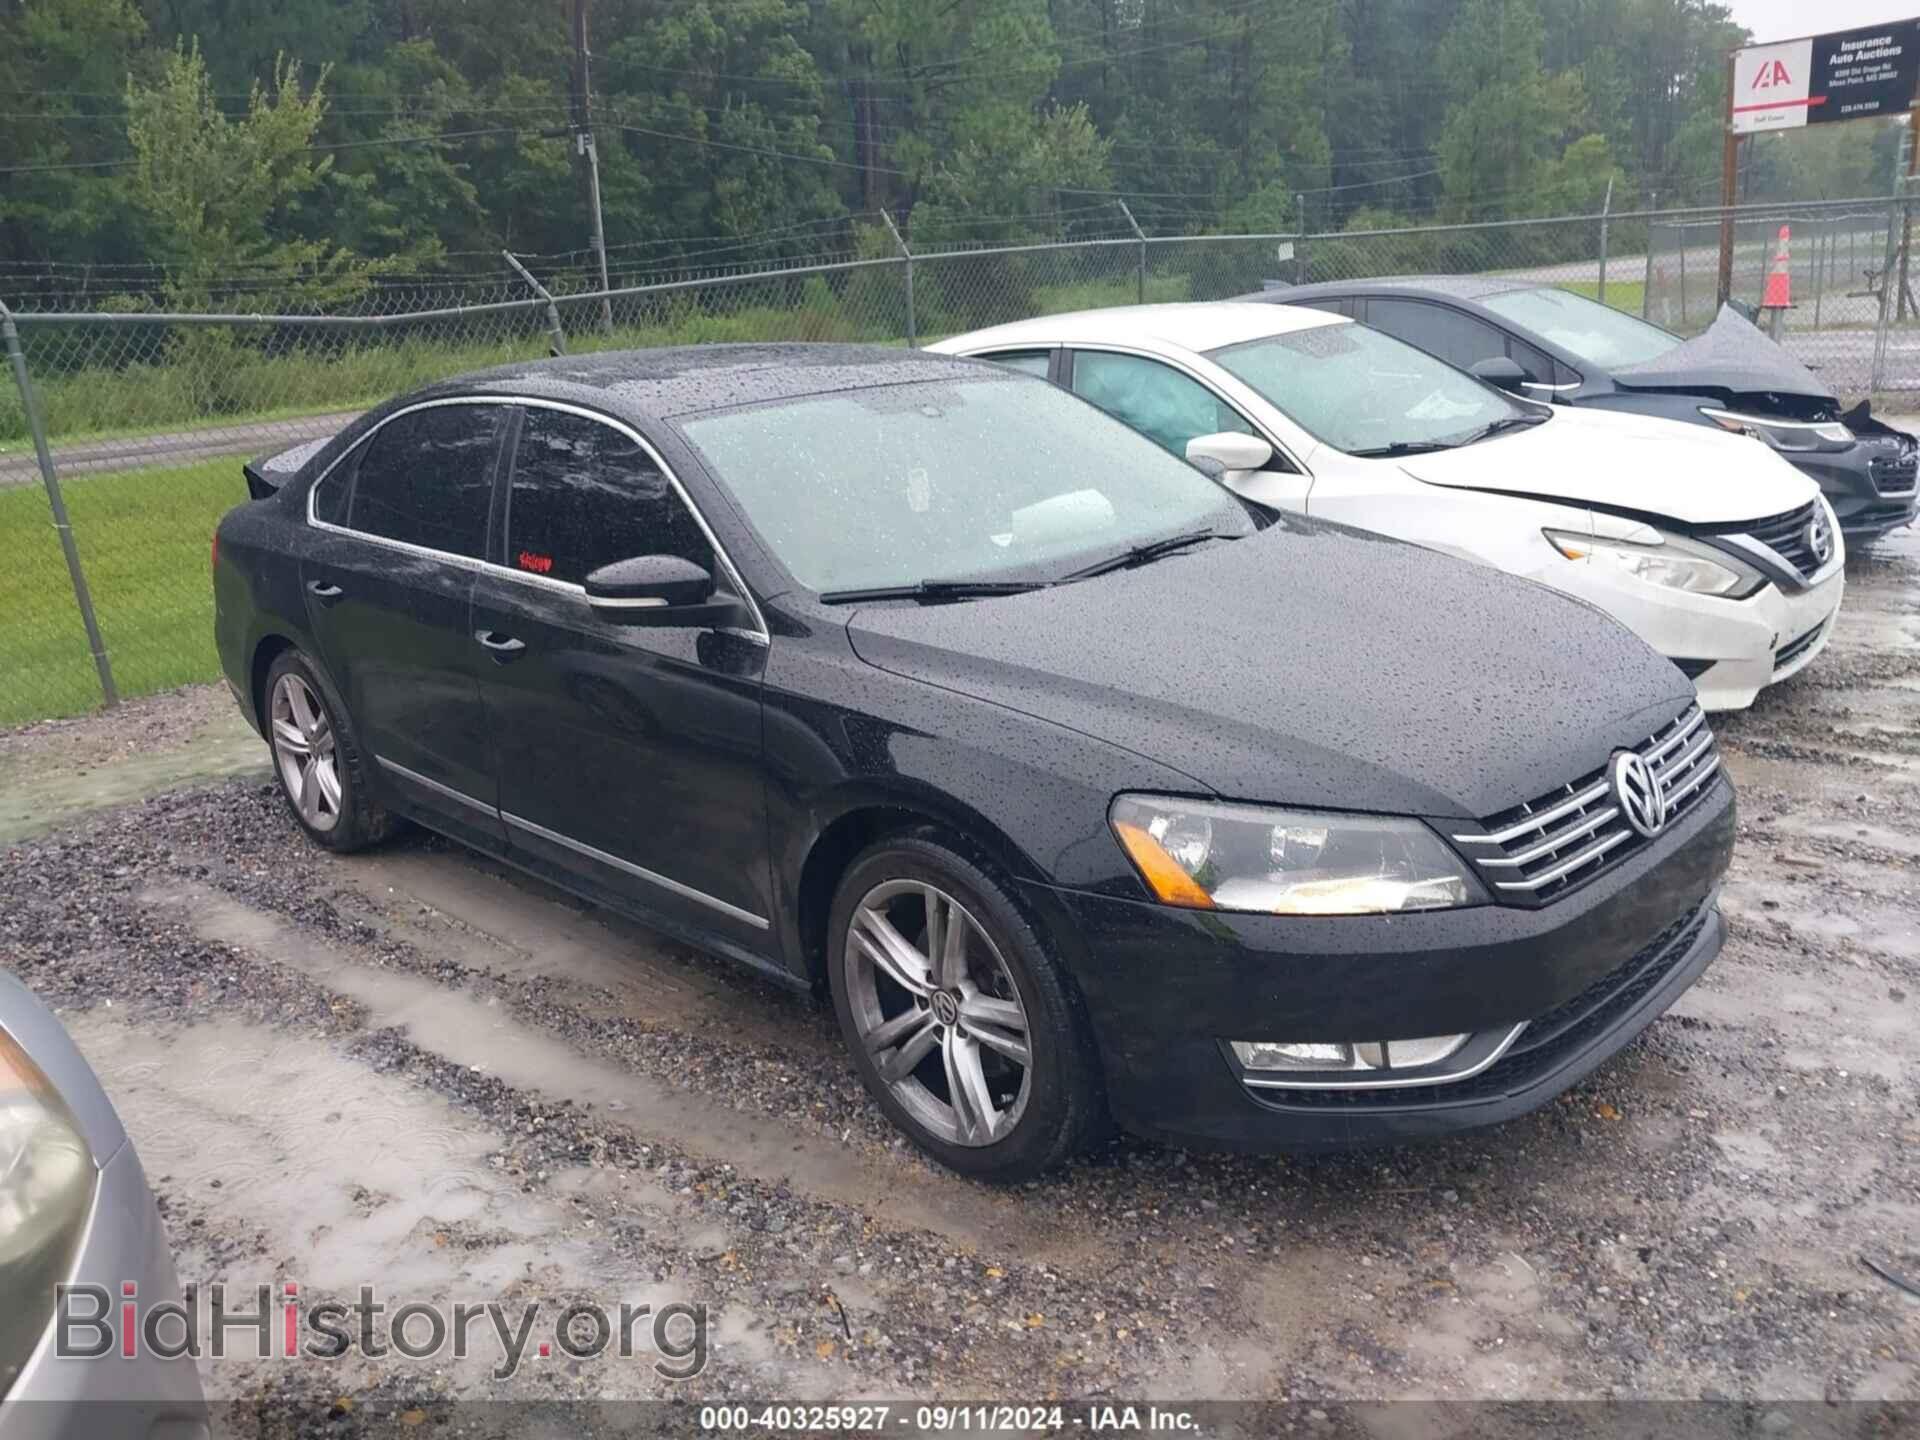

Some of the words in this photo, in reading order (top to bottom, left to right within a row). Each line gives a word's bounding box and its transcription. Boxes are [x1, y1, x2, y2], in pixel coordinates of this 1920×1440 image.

[1841, 35, 1892, 52] Insurance
[1829, 51, 1853, 65] Auto
[1856, 45, 1902, 61] Auctions
